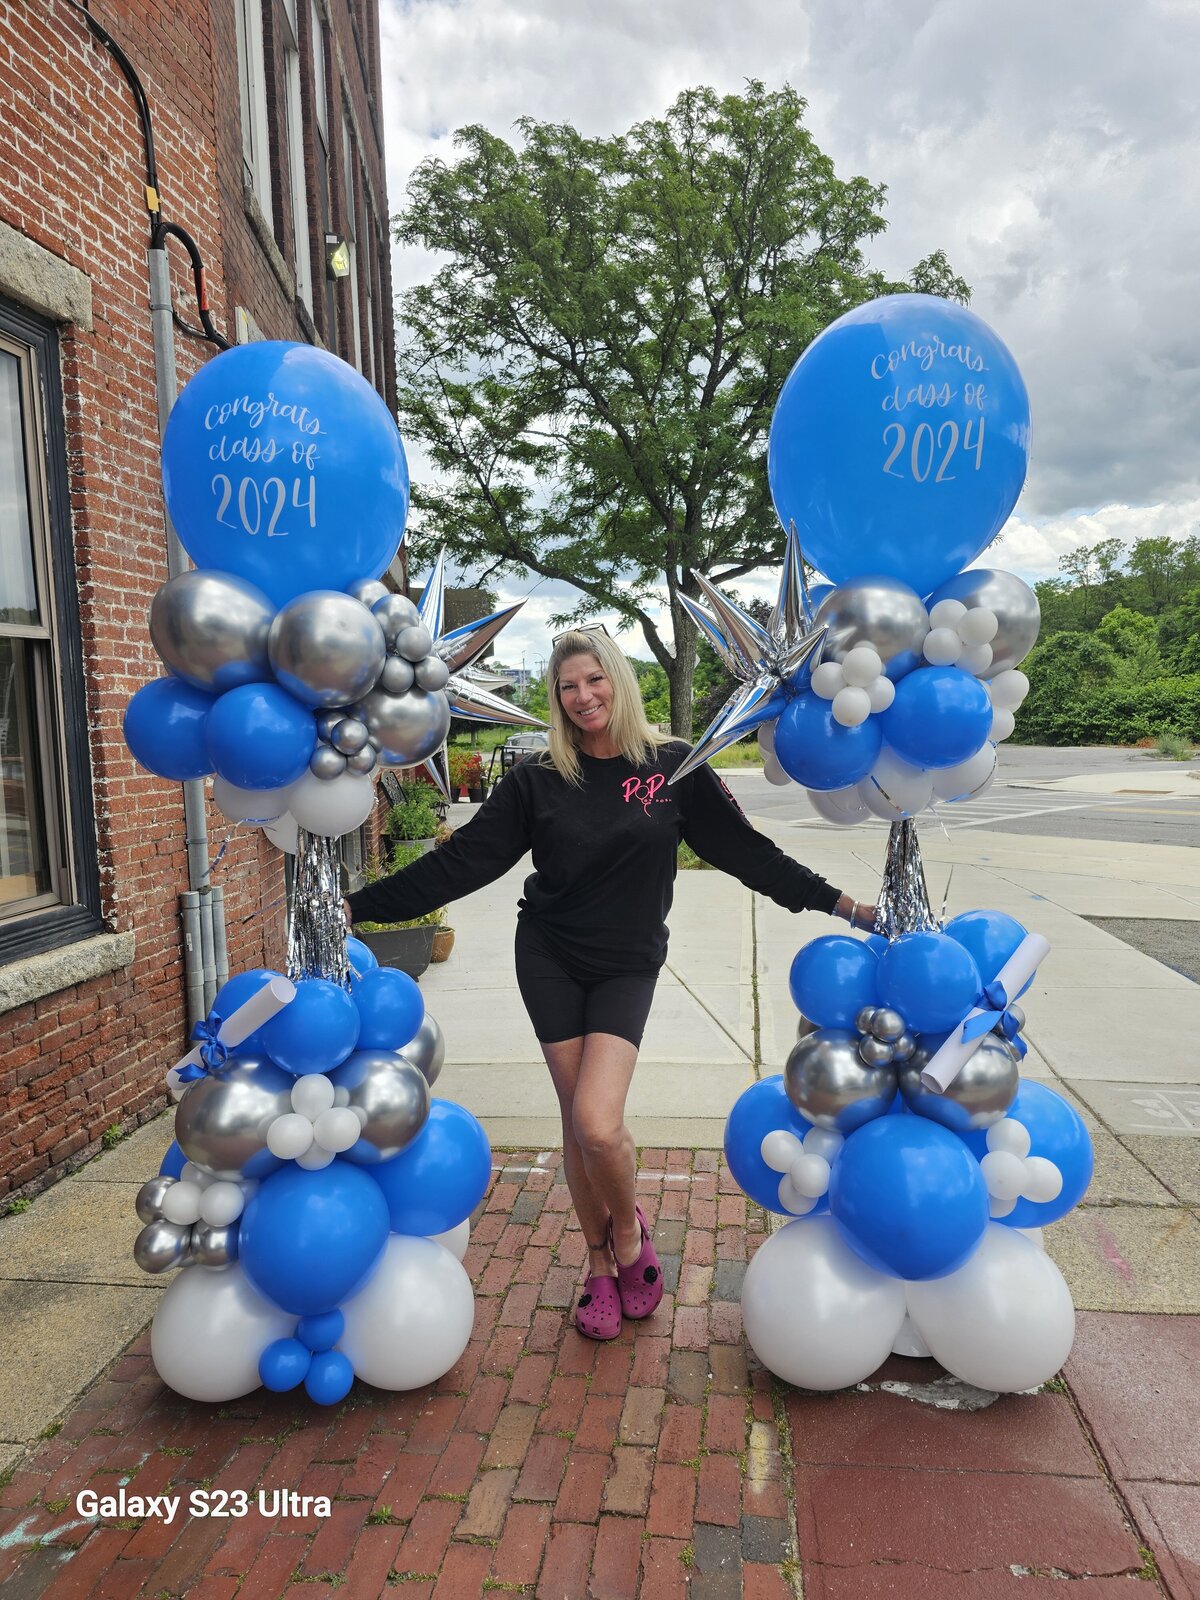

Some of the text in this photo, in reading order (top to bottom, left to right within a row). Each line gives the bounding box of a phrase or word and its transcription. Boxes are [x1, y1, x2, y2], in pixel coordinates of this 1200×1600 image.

[881, 382, 988, 412] class of
[208, 435, 320, 470] class of
[882, 416, 984, 482] 2024
[211, 473, 316, 537] 2024
